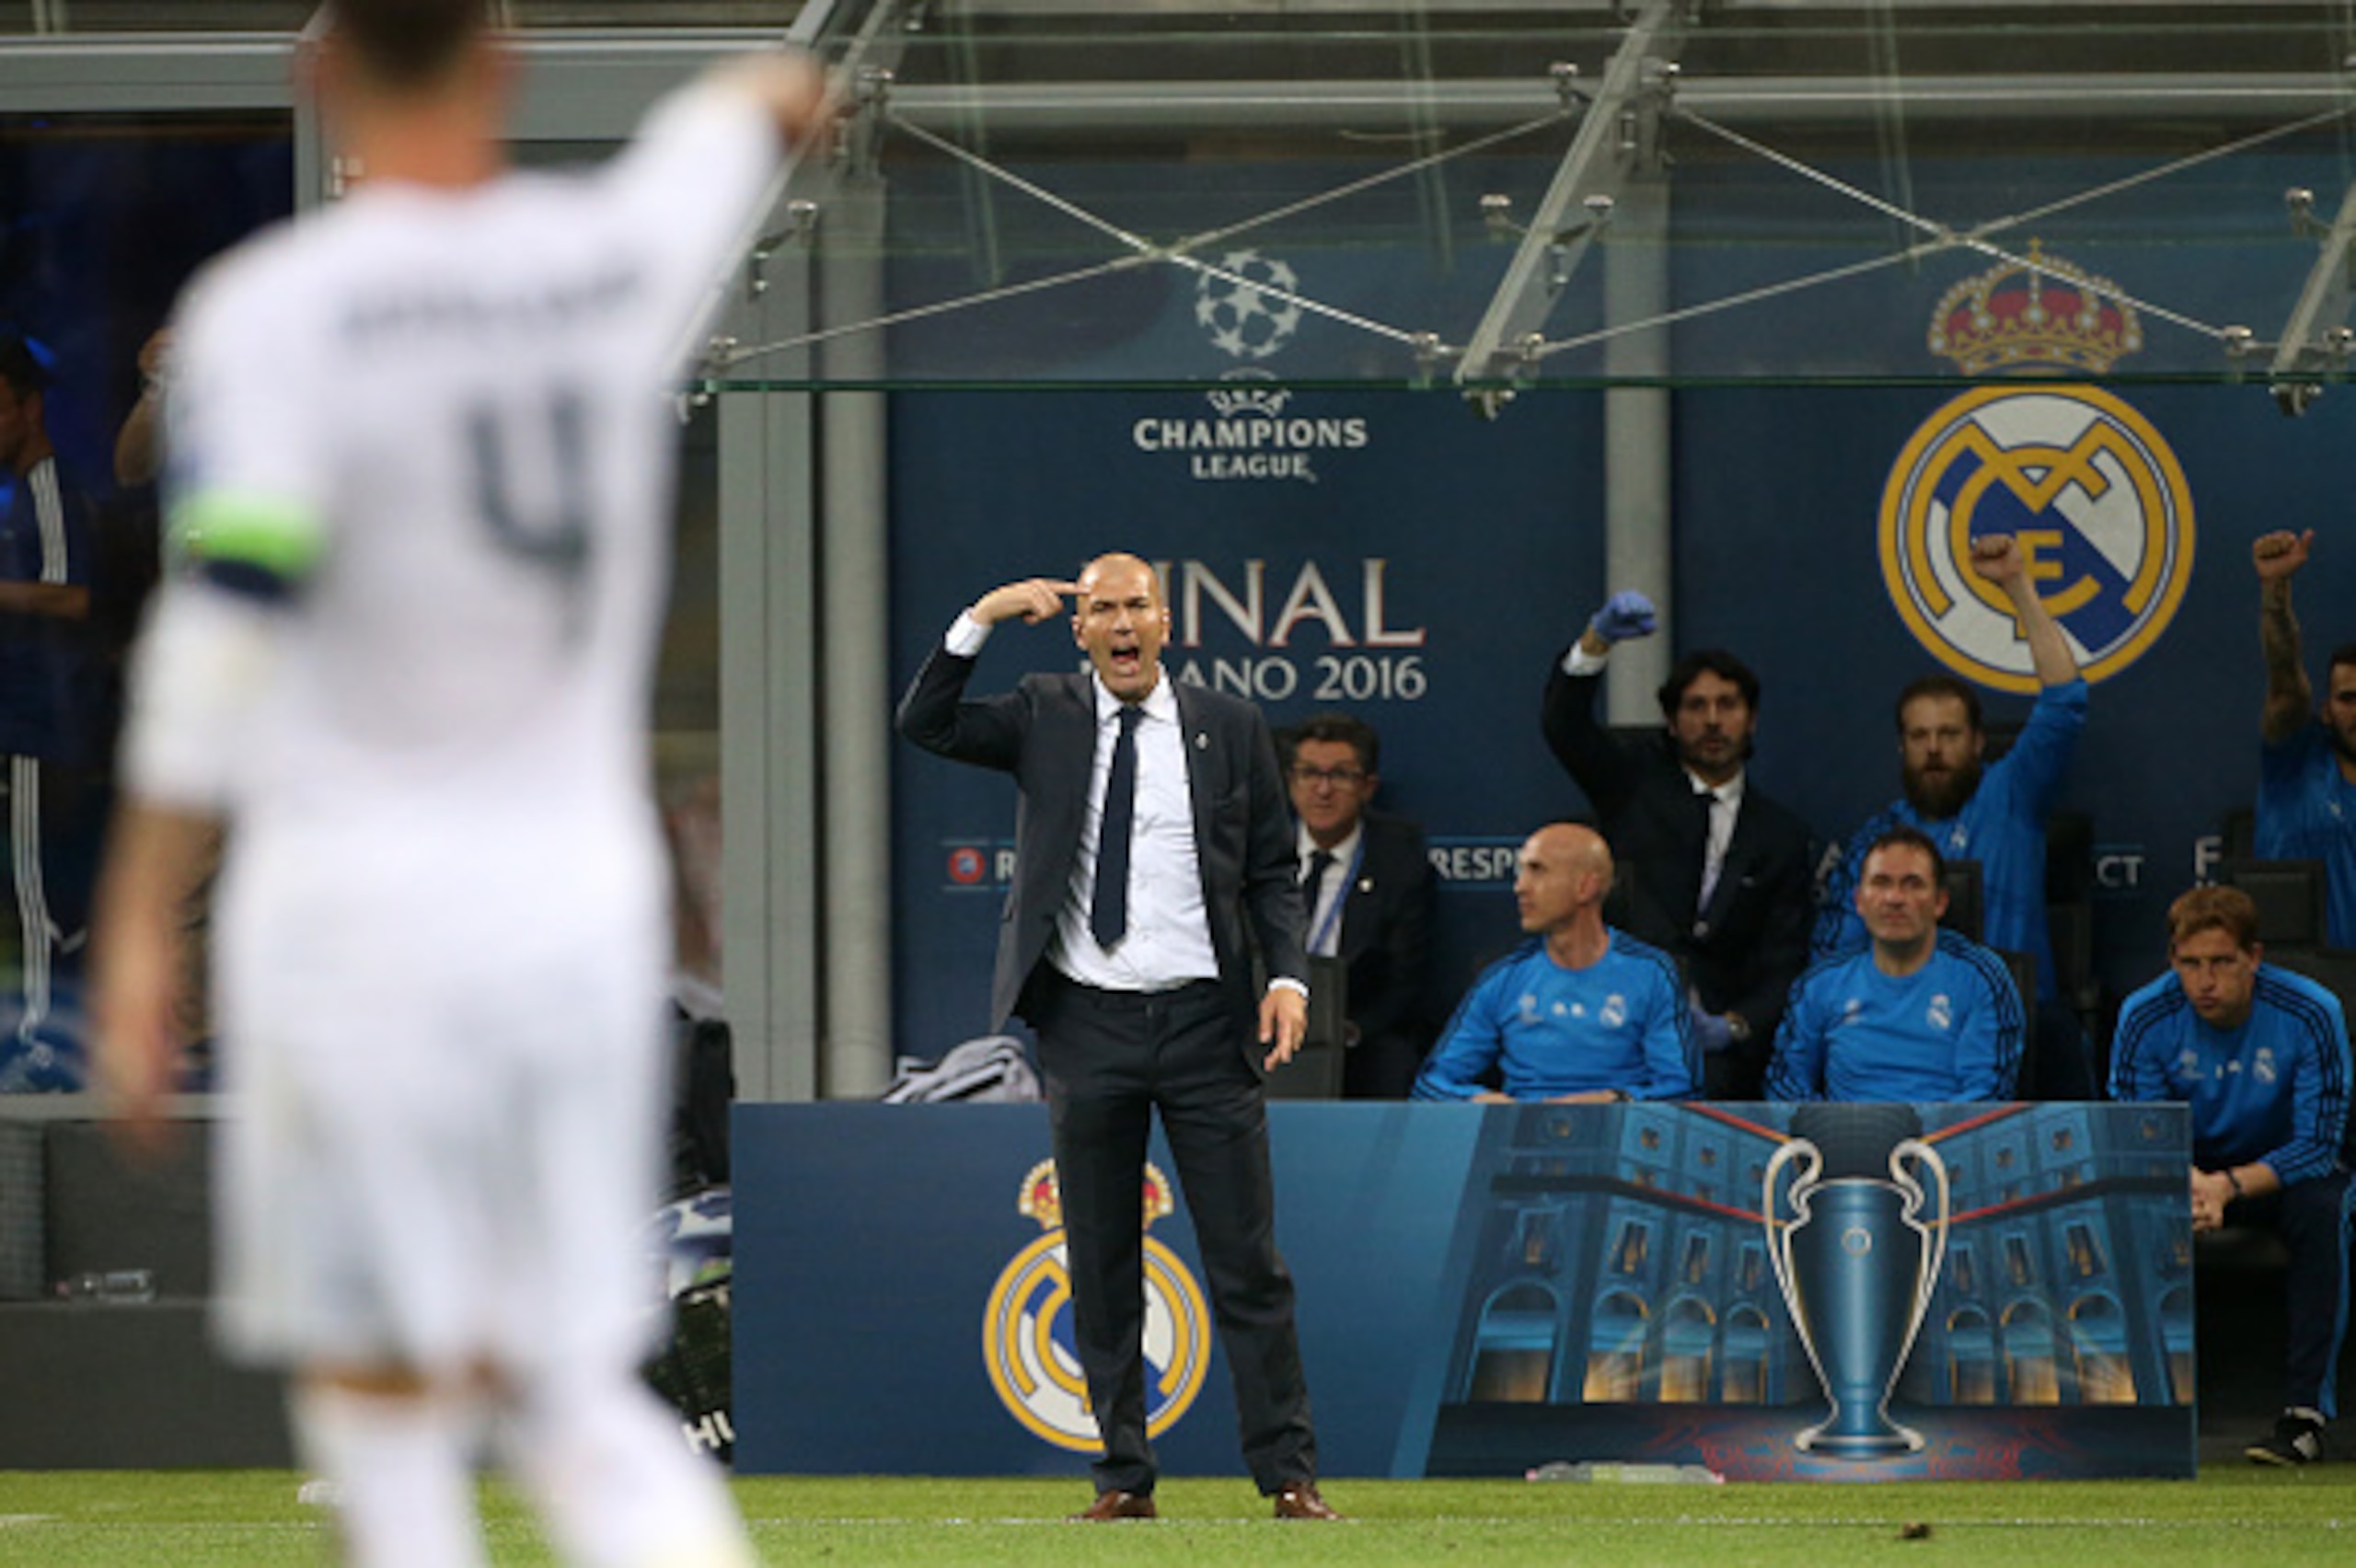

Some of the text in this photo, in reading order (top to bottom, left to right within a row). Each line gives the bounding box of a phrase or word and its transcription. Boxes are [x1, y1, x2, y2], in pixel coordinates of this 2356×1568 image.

[1133, 419, 1369, 450] CHAMPIONS
[1191, 455, 1309, 479] LEAGUE
[1313, 655, 1427, 700] 2016
